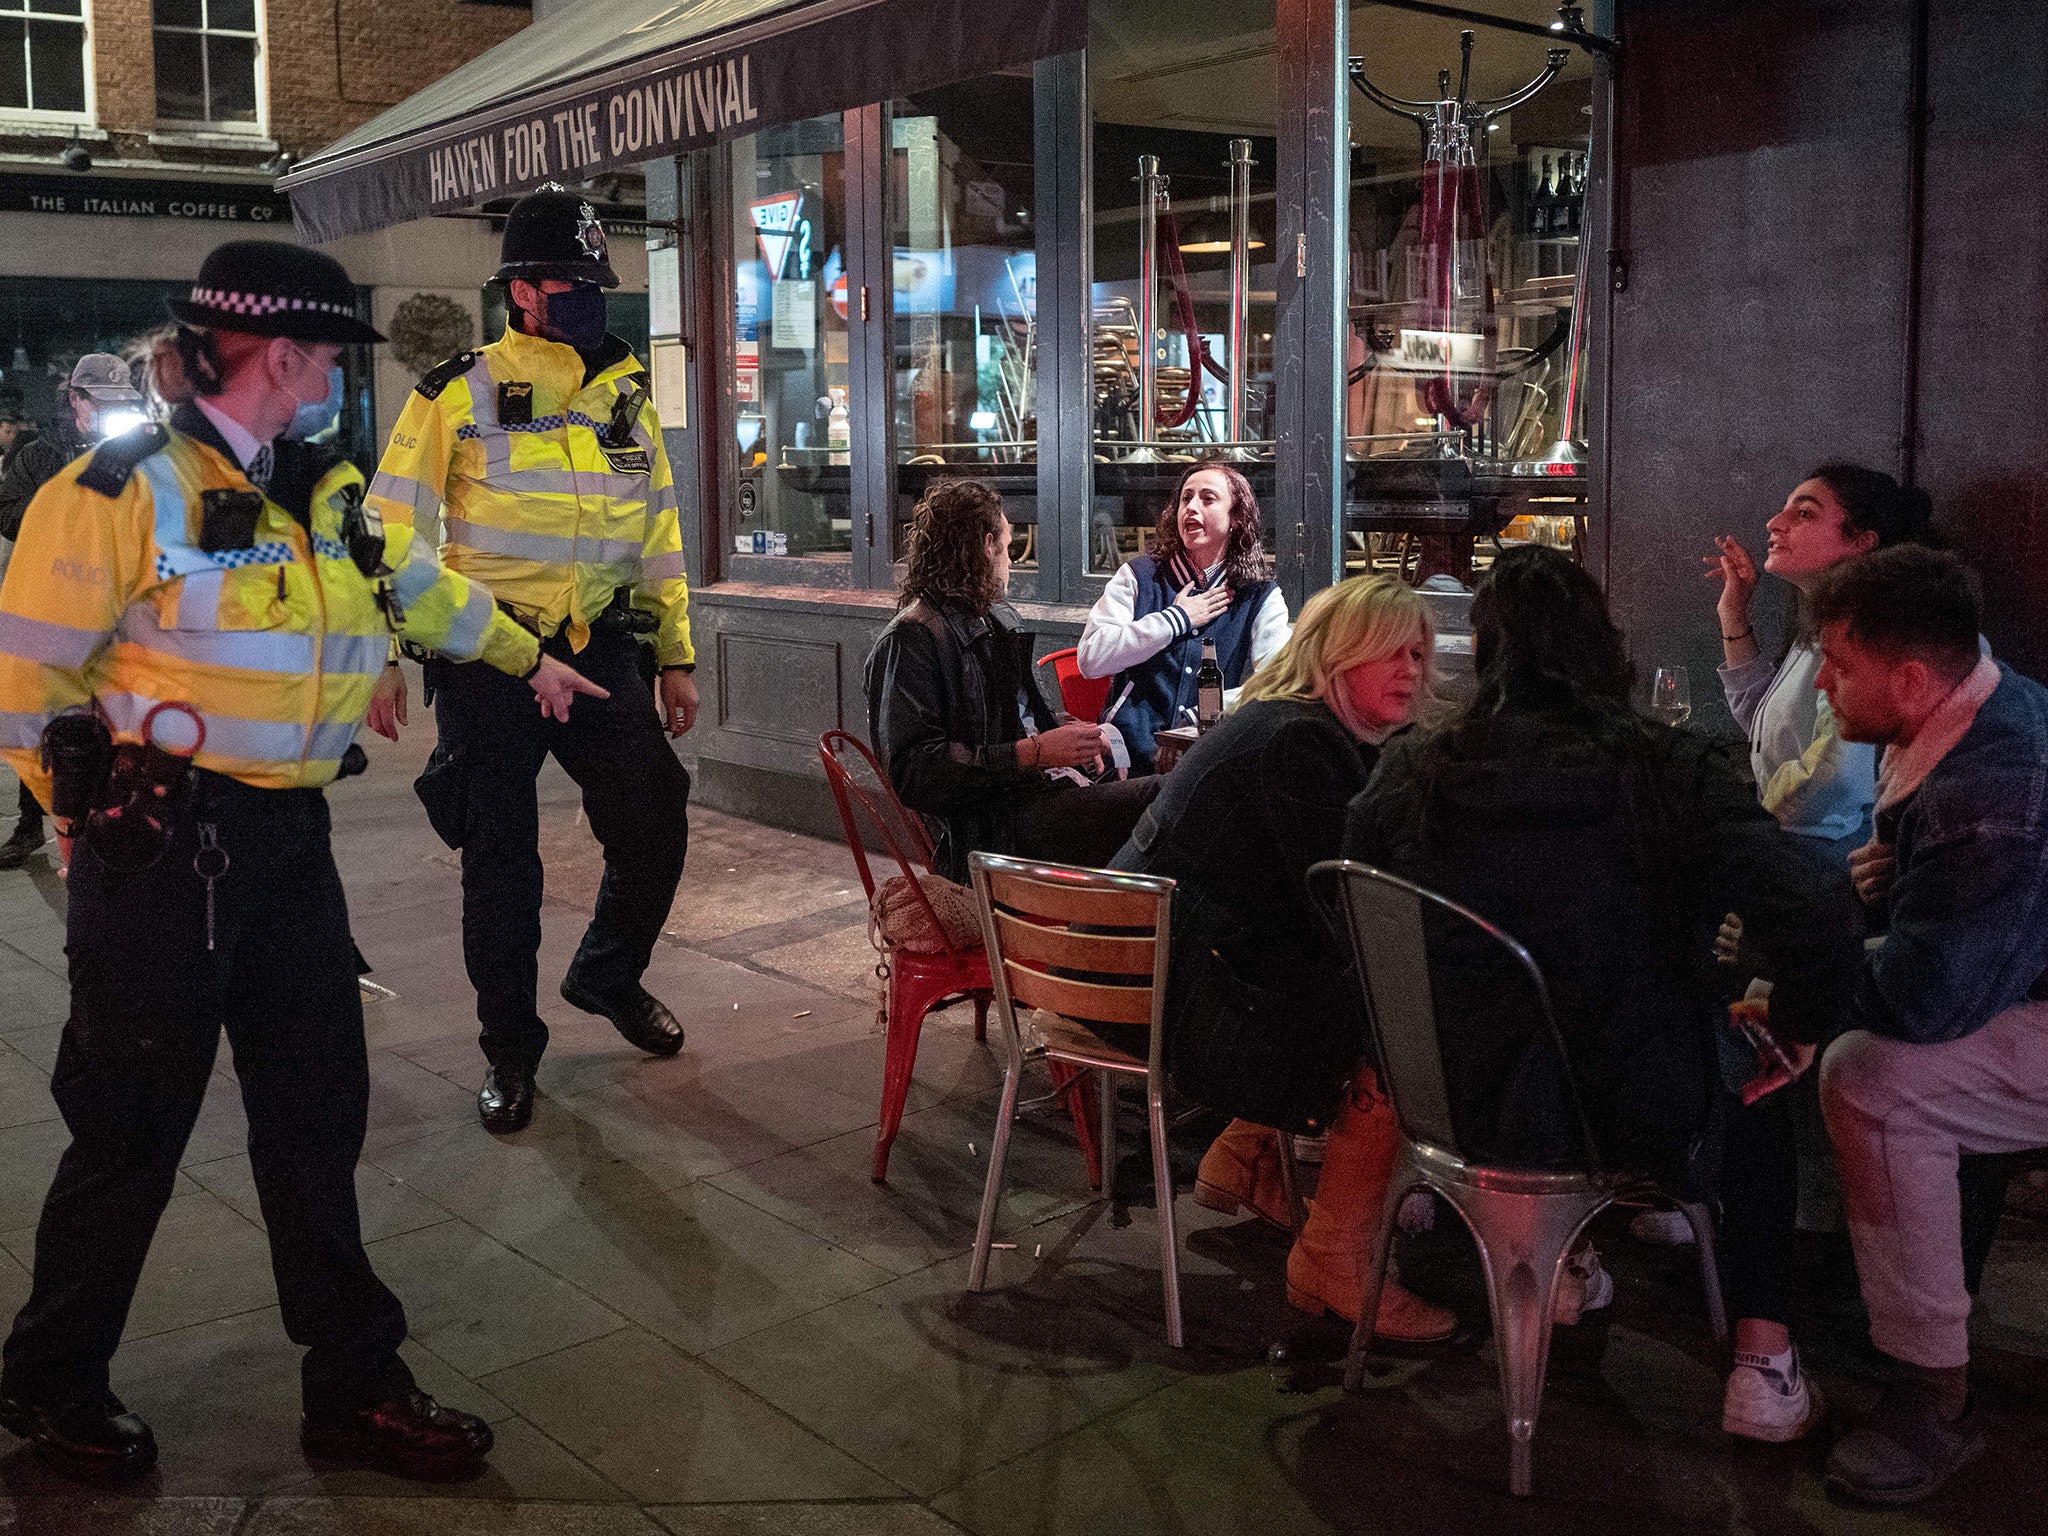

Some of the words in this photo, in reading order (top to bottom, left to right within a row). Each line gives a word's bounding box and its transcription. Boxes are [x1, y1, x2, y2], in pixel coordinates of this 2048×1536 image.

[429, 131, 496, 203] HAVEN
[503, 118, 549, 184] FOR
[553, 102, 602, 171] THE
[609, 54, 758, 157] CONVIVIAL
[30, 195, 65, 212] THE
[84, 198, 155, 215] ITALIAN
[168, 201, 237, 219] COFFEE
[393, 432, 417, 449] OLIC
[52, 557, 107, 587] POLIC
[1737, 1353, 1770, 1366] uma
